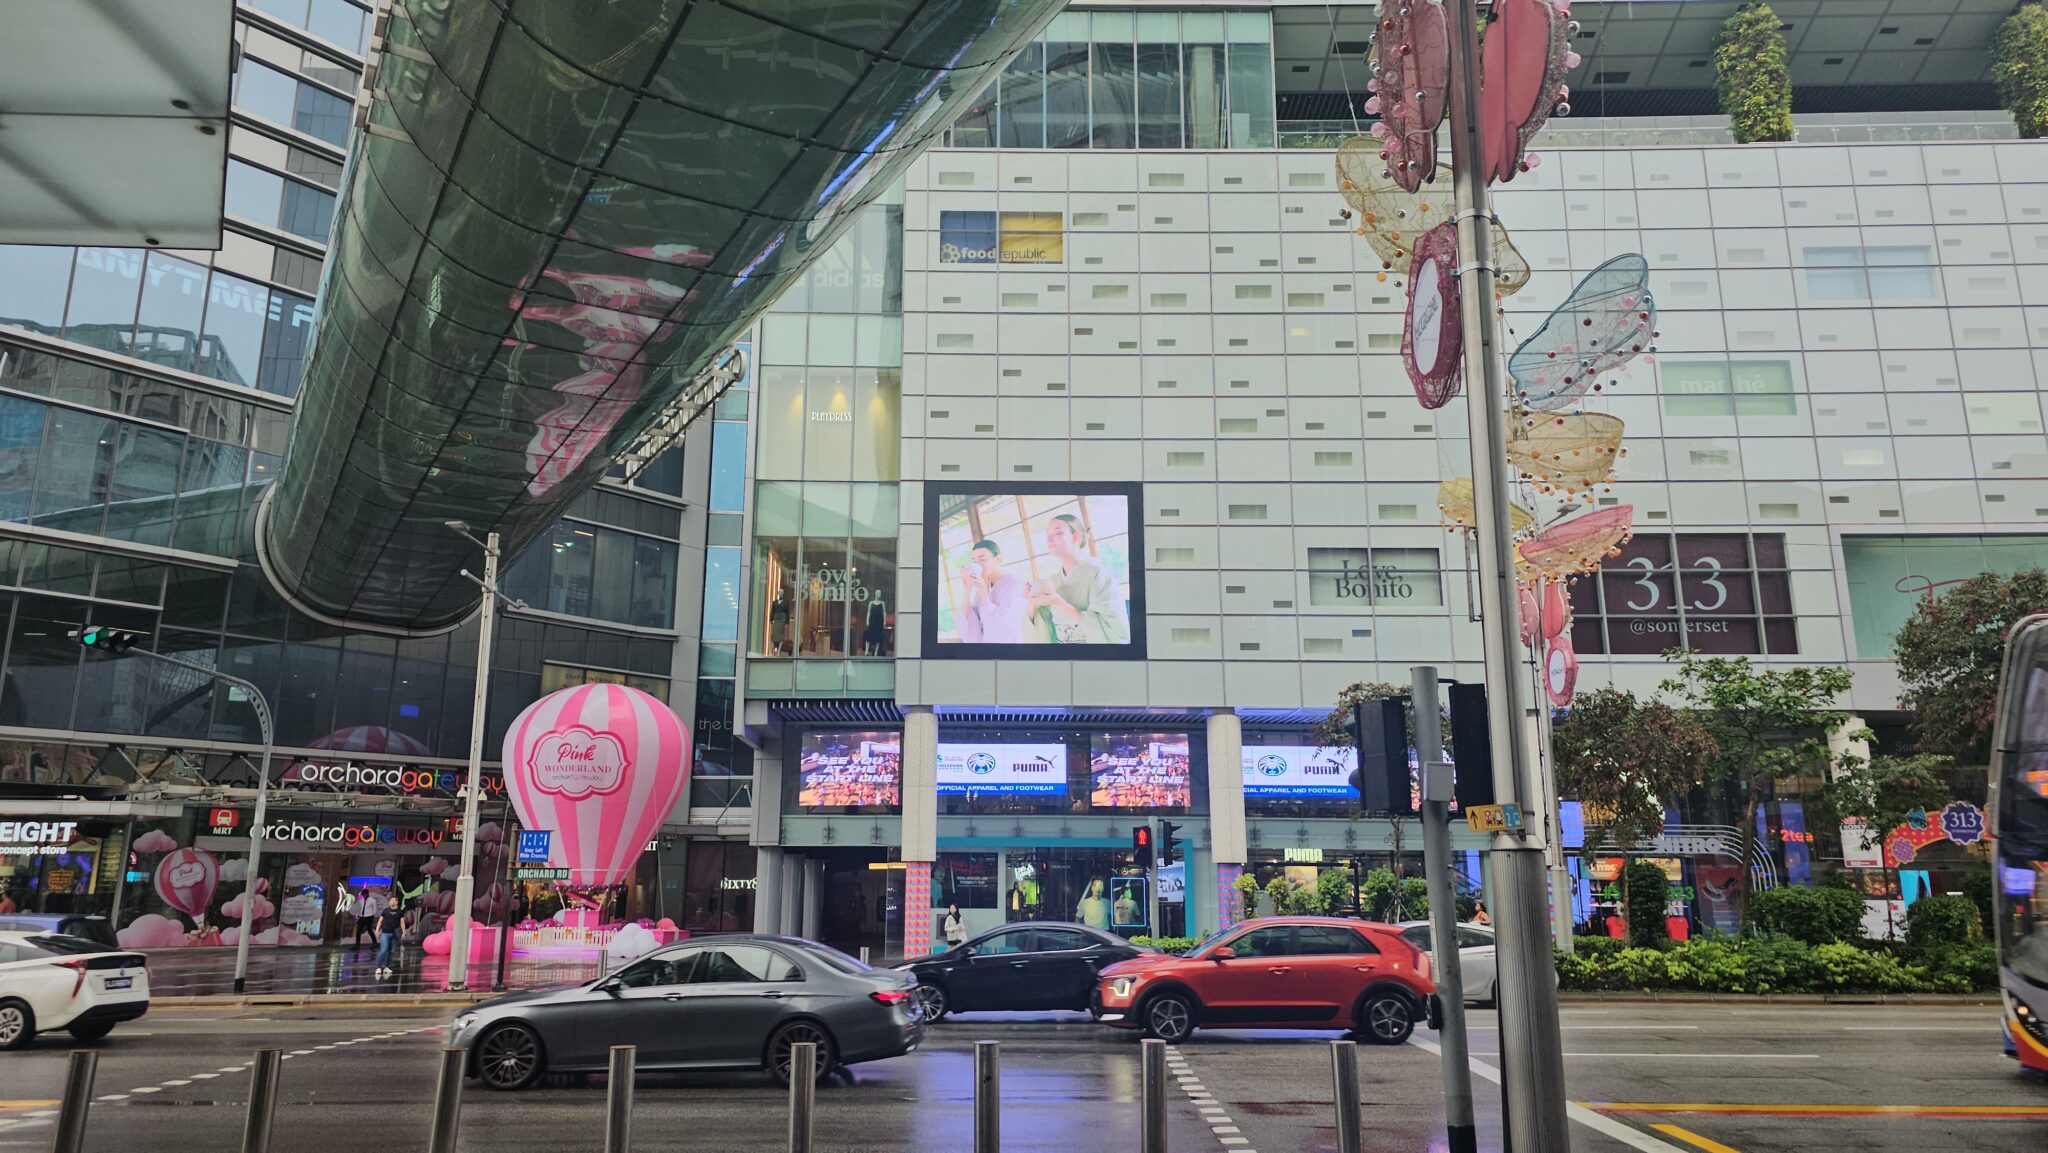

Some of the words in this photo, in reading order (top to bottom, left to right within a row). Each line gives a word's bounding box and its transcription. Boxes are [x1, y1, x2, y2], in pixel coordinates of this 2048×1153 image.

[961, 247, 997, 259] food
[999, 247, 1047, 262] republic
[1680, 373, 1766, 394] marhé
[811, 411, 852, 421] PLAYDRESS
[1335, 577, 1413, 598] Bonito
[557, 742, 597, 763] Pink
[818, 756, 849, 765] SEE
[852, 756, 884, 765] YOU
[1107, 757, 1138, 766] SEE
[1142, 757, 1174, 766] YOU
[545, 764, 612, 774] WONDERLAND
[823, 765, 844, 774] AT
[847, 765, 877, 774] THE
[1013, 763, 1048, 772] PUMA
[1113, 766, 1134, 775] AT
[1136, 766, 1167, 775] THE
[1304, 765, 1340, 775] PUMA
[806, 774, 856, 783] START
[858, 774, 894, 783] LINE
[1097, 775, 1147, 784] START
[1149, 775, 1185, 784] LINE
[1950, 811, 1977, 828] 313
[0, 821, 77, 843] EIGHT
[213, 826, 233, 835] MRT
[250, 820, 445, 849] orchardgateway
[452, 832, 464, 841] MR
[40, 845, 68, 855] store
[1284, 848, 1323, 862] PUMA
[518, 868, 555, 879] ORCHARD
[557, 869, 568, 878] RD
